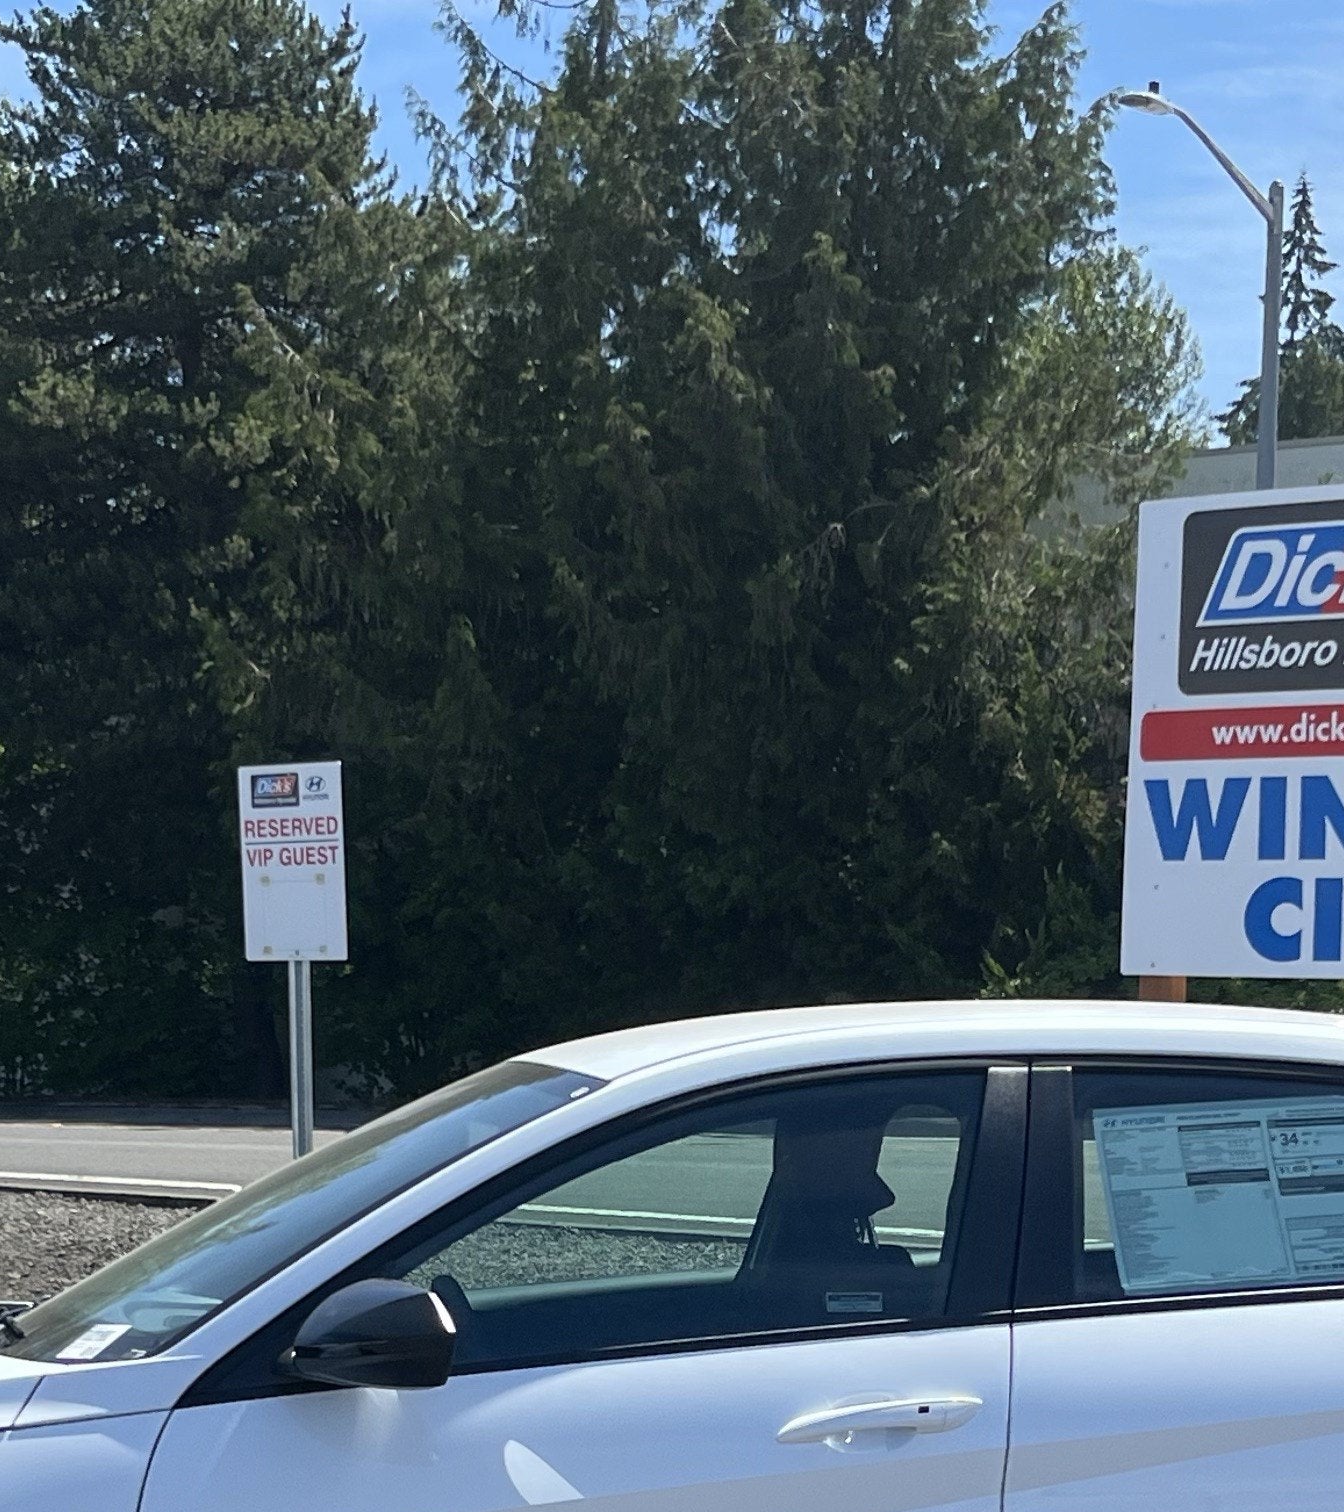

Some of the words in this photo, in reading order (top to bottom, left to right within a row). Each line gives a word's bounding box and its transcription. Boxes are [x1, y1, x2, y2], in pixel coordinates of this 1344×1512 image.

[1189, 635, 1339, 673] Hillsboro
[244, 816, 338, 838] RESERVED
[246, 848, 273, 867] VIP
[279, 845, 338, 866] GUEST
